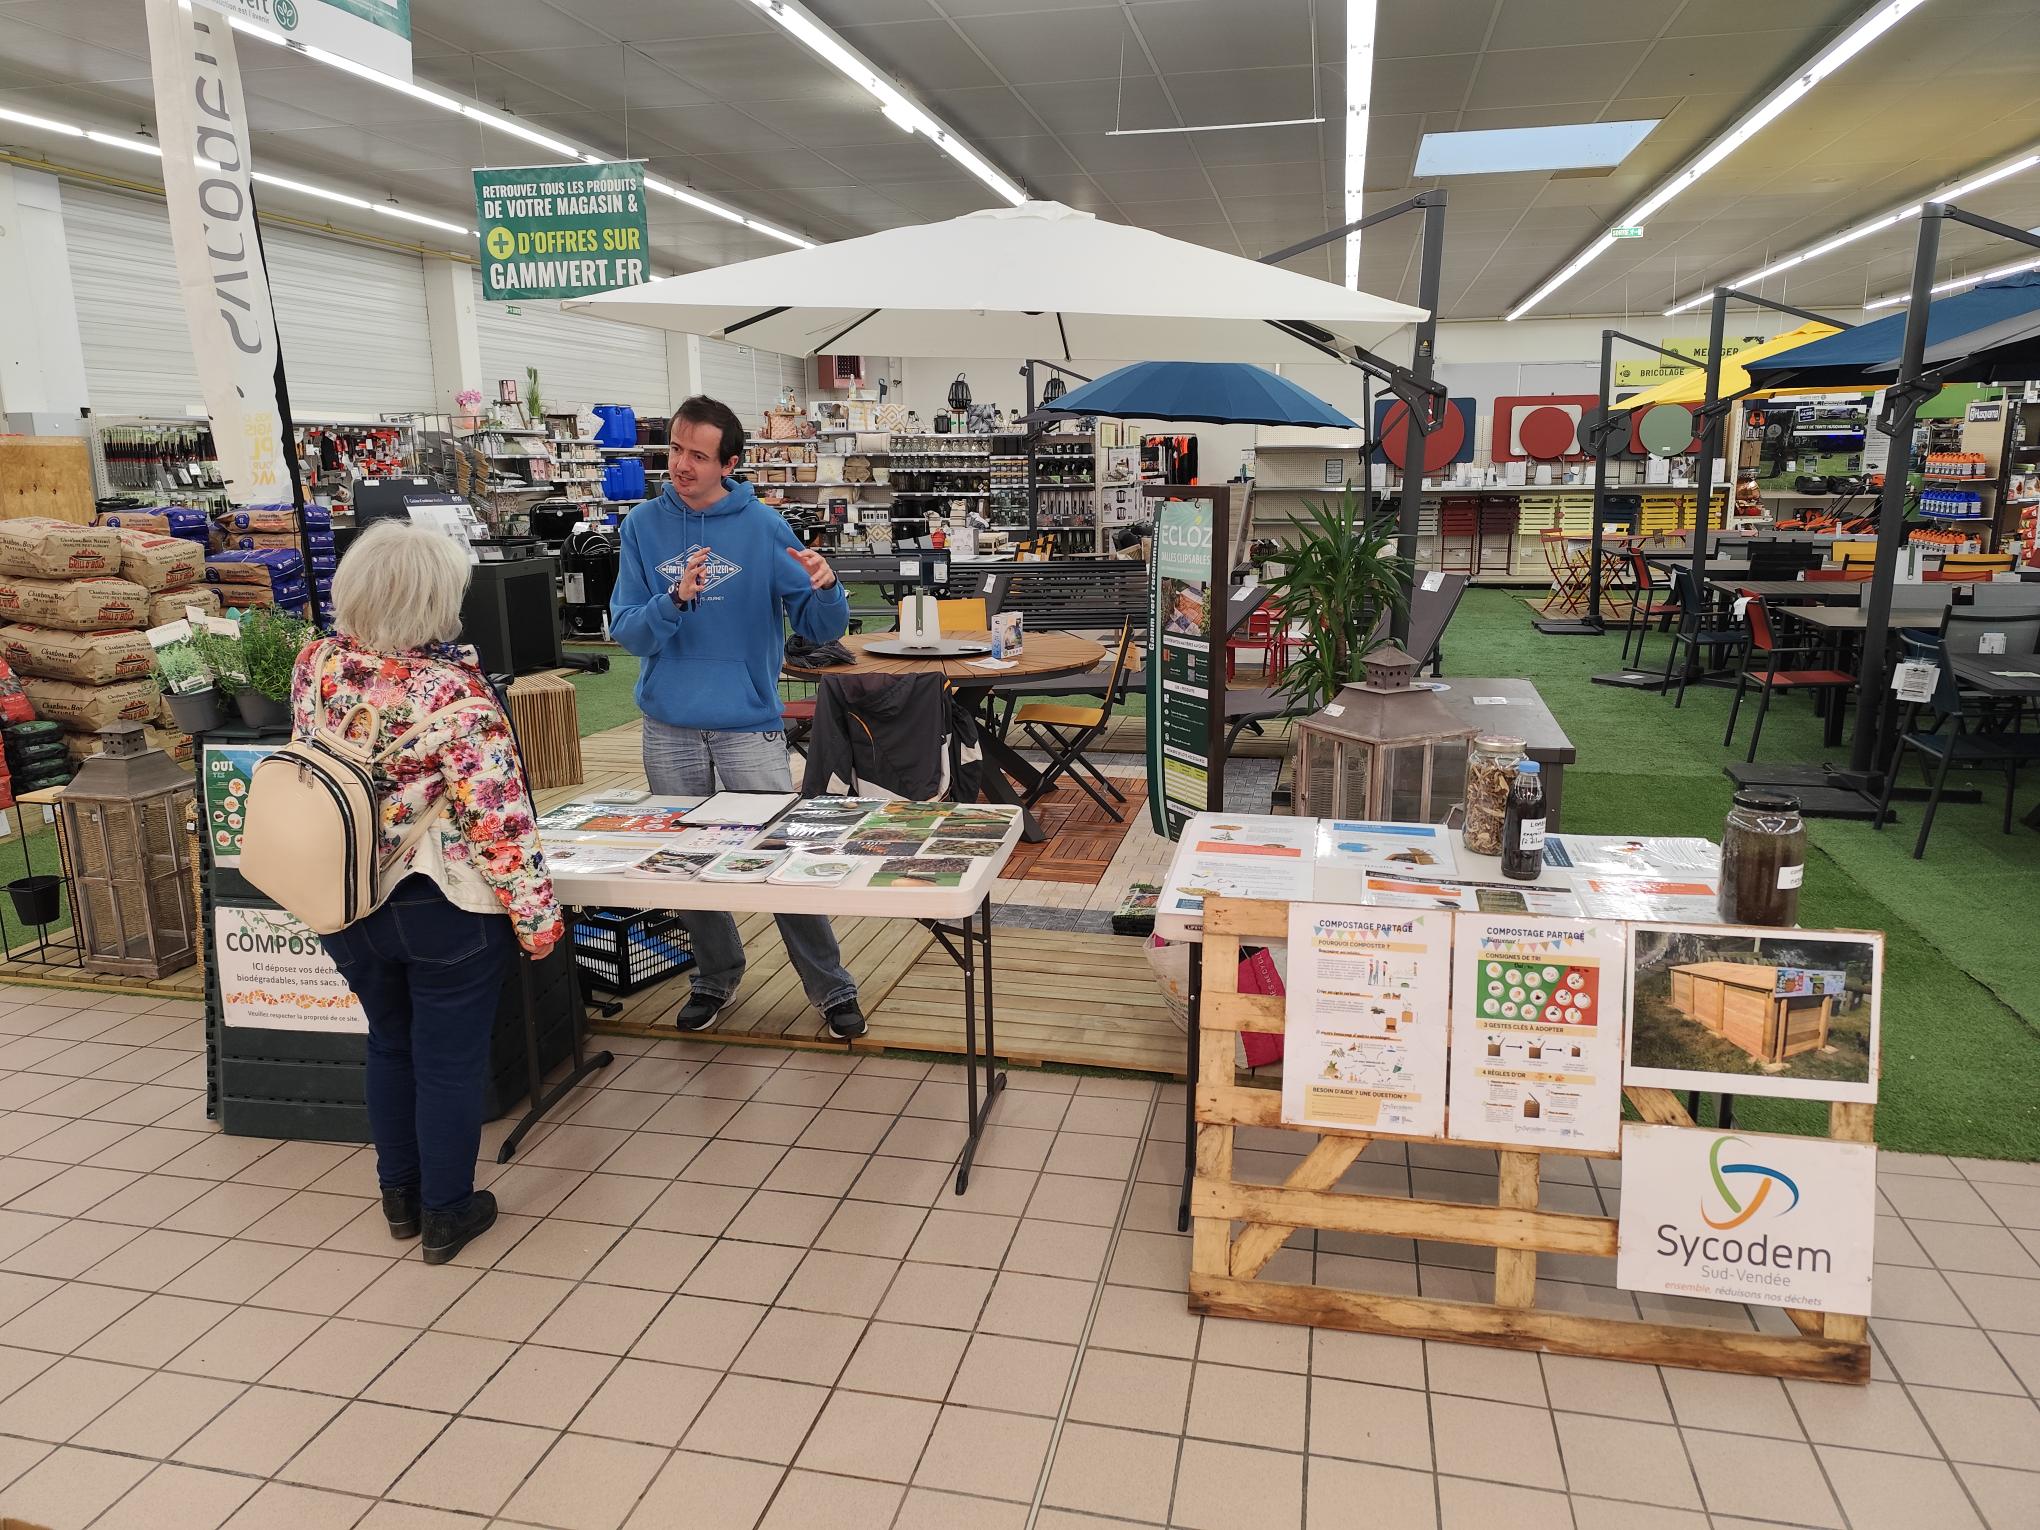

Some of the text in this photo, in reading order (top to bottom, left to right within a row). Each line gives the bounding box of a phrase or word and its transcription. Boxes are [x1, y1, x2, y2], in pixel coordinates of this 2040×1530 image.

[482, 178, 637, 198] RETROUVEZ TOUS LES PRODUITS
[484, 194, 638, 219] DE VOTRE MAGASIN &
[517, 230, 599, 254] D'OFFRES
[602, 227, 640, 250] SUR
[490, 258, 644, 290] GAMMVERT.FR
[1694, 348, 1739, 357] MEGER
[1640, 368, 1685, 377] BRICOLAGE
[706, 565, 729, 573] CITIZEN
[211, 761, 234, 772] OUI
[1320, 920, 1374, 930] COMPOSTAGE
[1487, 927, 1544, 938] COMPOSTAGE
[252, 962, 264, 971] ICI
[265, 963, 296, 975] déposez
[315, 965, 338, 974] déche
[237, 974, 299, 986] biodégradables,
[1657, 1224, 1831, 1273] Sycodem
[1701, 1265, 1791, 1287] Sud-Vendée
[1714, 1286, 1762, 1300] réduisons
[1764, 1292, 1782, 1302] nos
[1784, 1292, 1822, 1306] déchets
